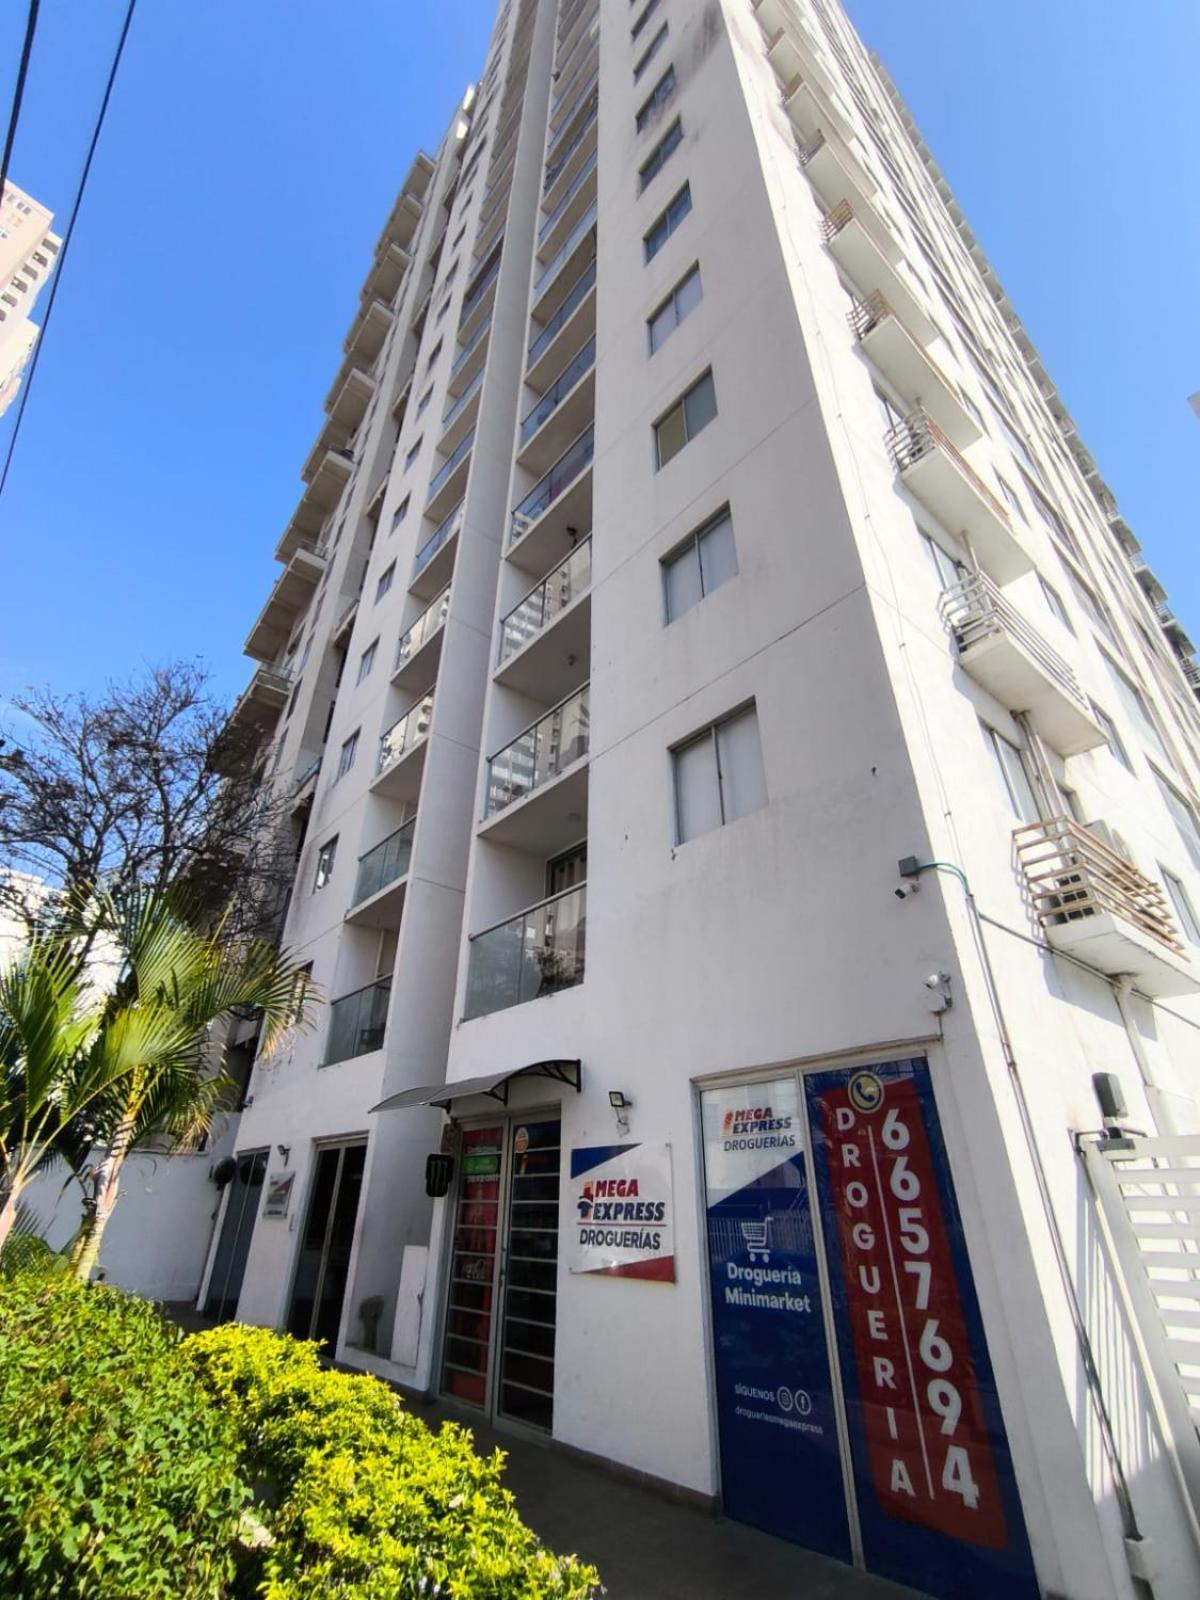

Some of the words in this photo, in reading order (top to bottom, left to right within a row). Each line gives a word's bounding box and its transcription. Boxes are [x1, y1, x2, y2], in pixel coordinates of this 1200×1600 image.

[735, 1107, 773, 1122] MEGA
[733, 1117, 793, 1134] EXPRESS
[595, 1179, 639, 1198] MEGA
[592, 1201, 666, 1222] EXPRESS
[579, 1228, 661, 1250] DROGUERÍAS
[725, 1286, 812, 1313] Minimarket
[881, 1108, 980, 1509] 6657694
